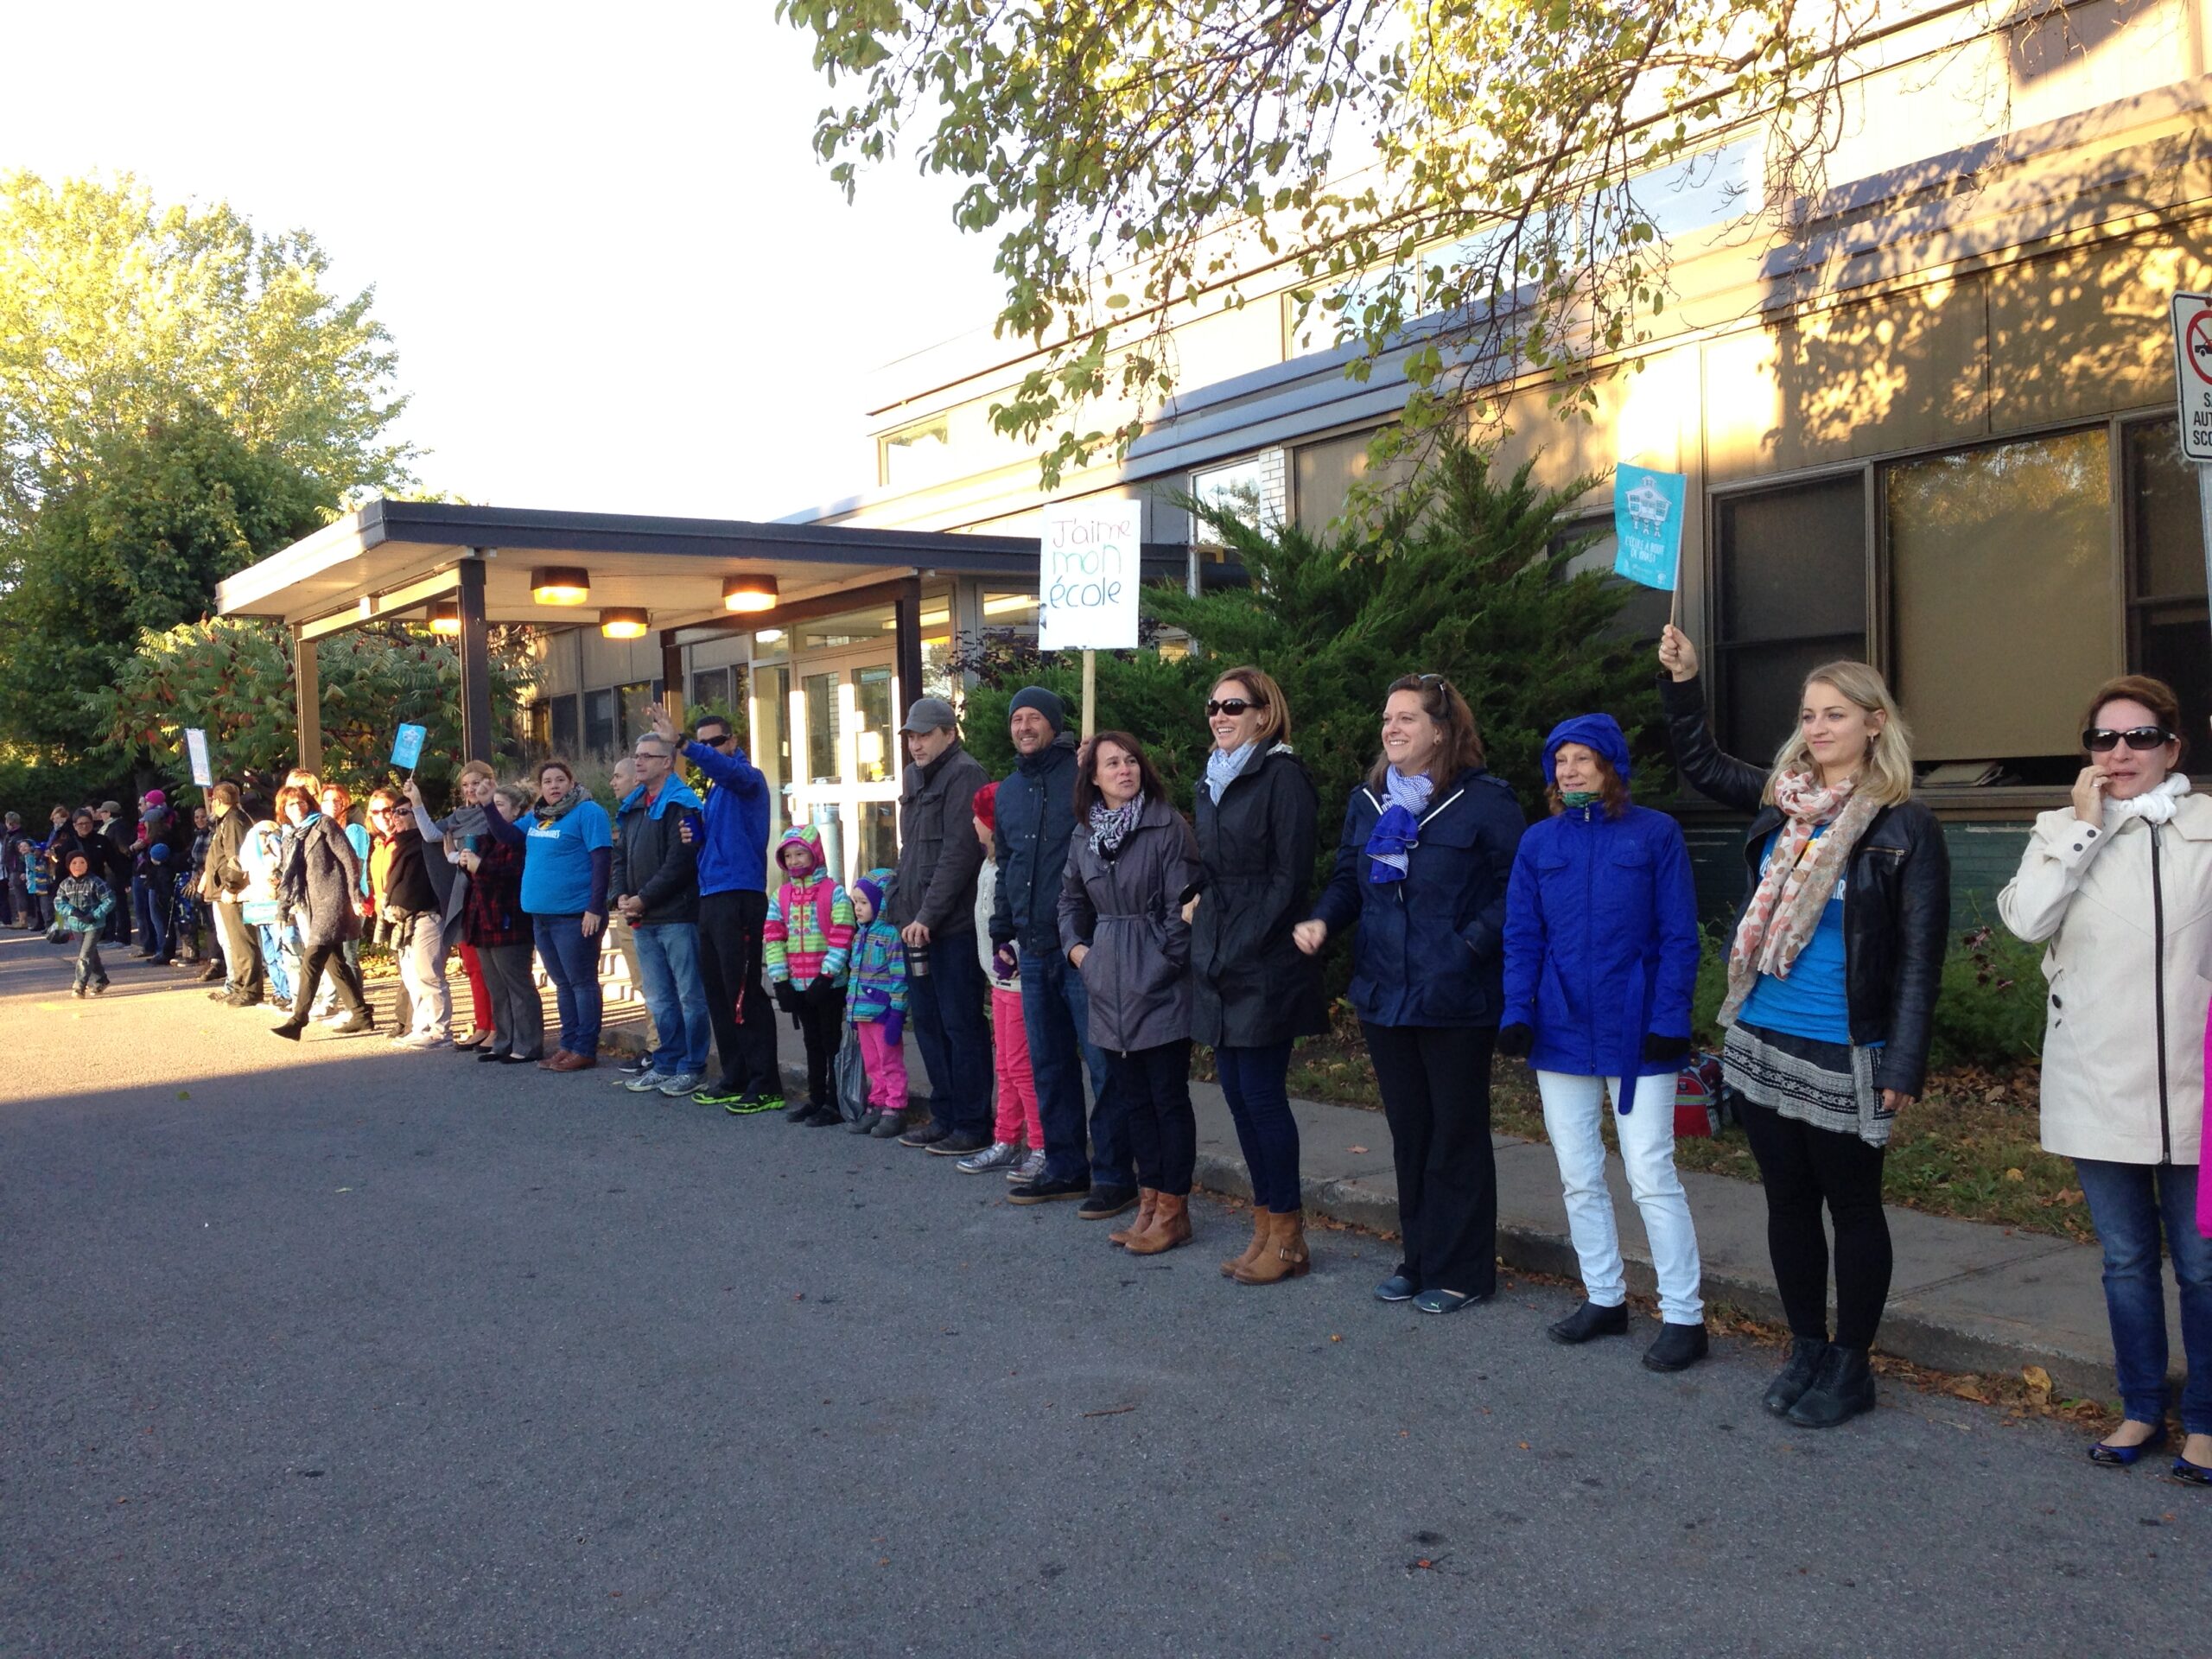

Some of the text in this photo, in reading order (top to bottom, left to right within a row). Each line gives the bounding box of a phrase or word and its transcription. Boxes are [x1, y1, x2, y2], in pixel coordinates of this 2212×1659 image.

[2203, 391, 2212, 408] S
[1052, 518, 1132, 549] J'aime
[1052, 543, 1122, 575] mon
[1050, 575, 1122, 609] école
